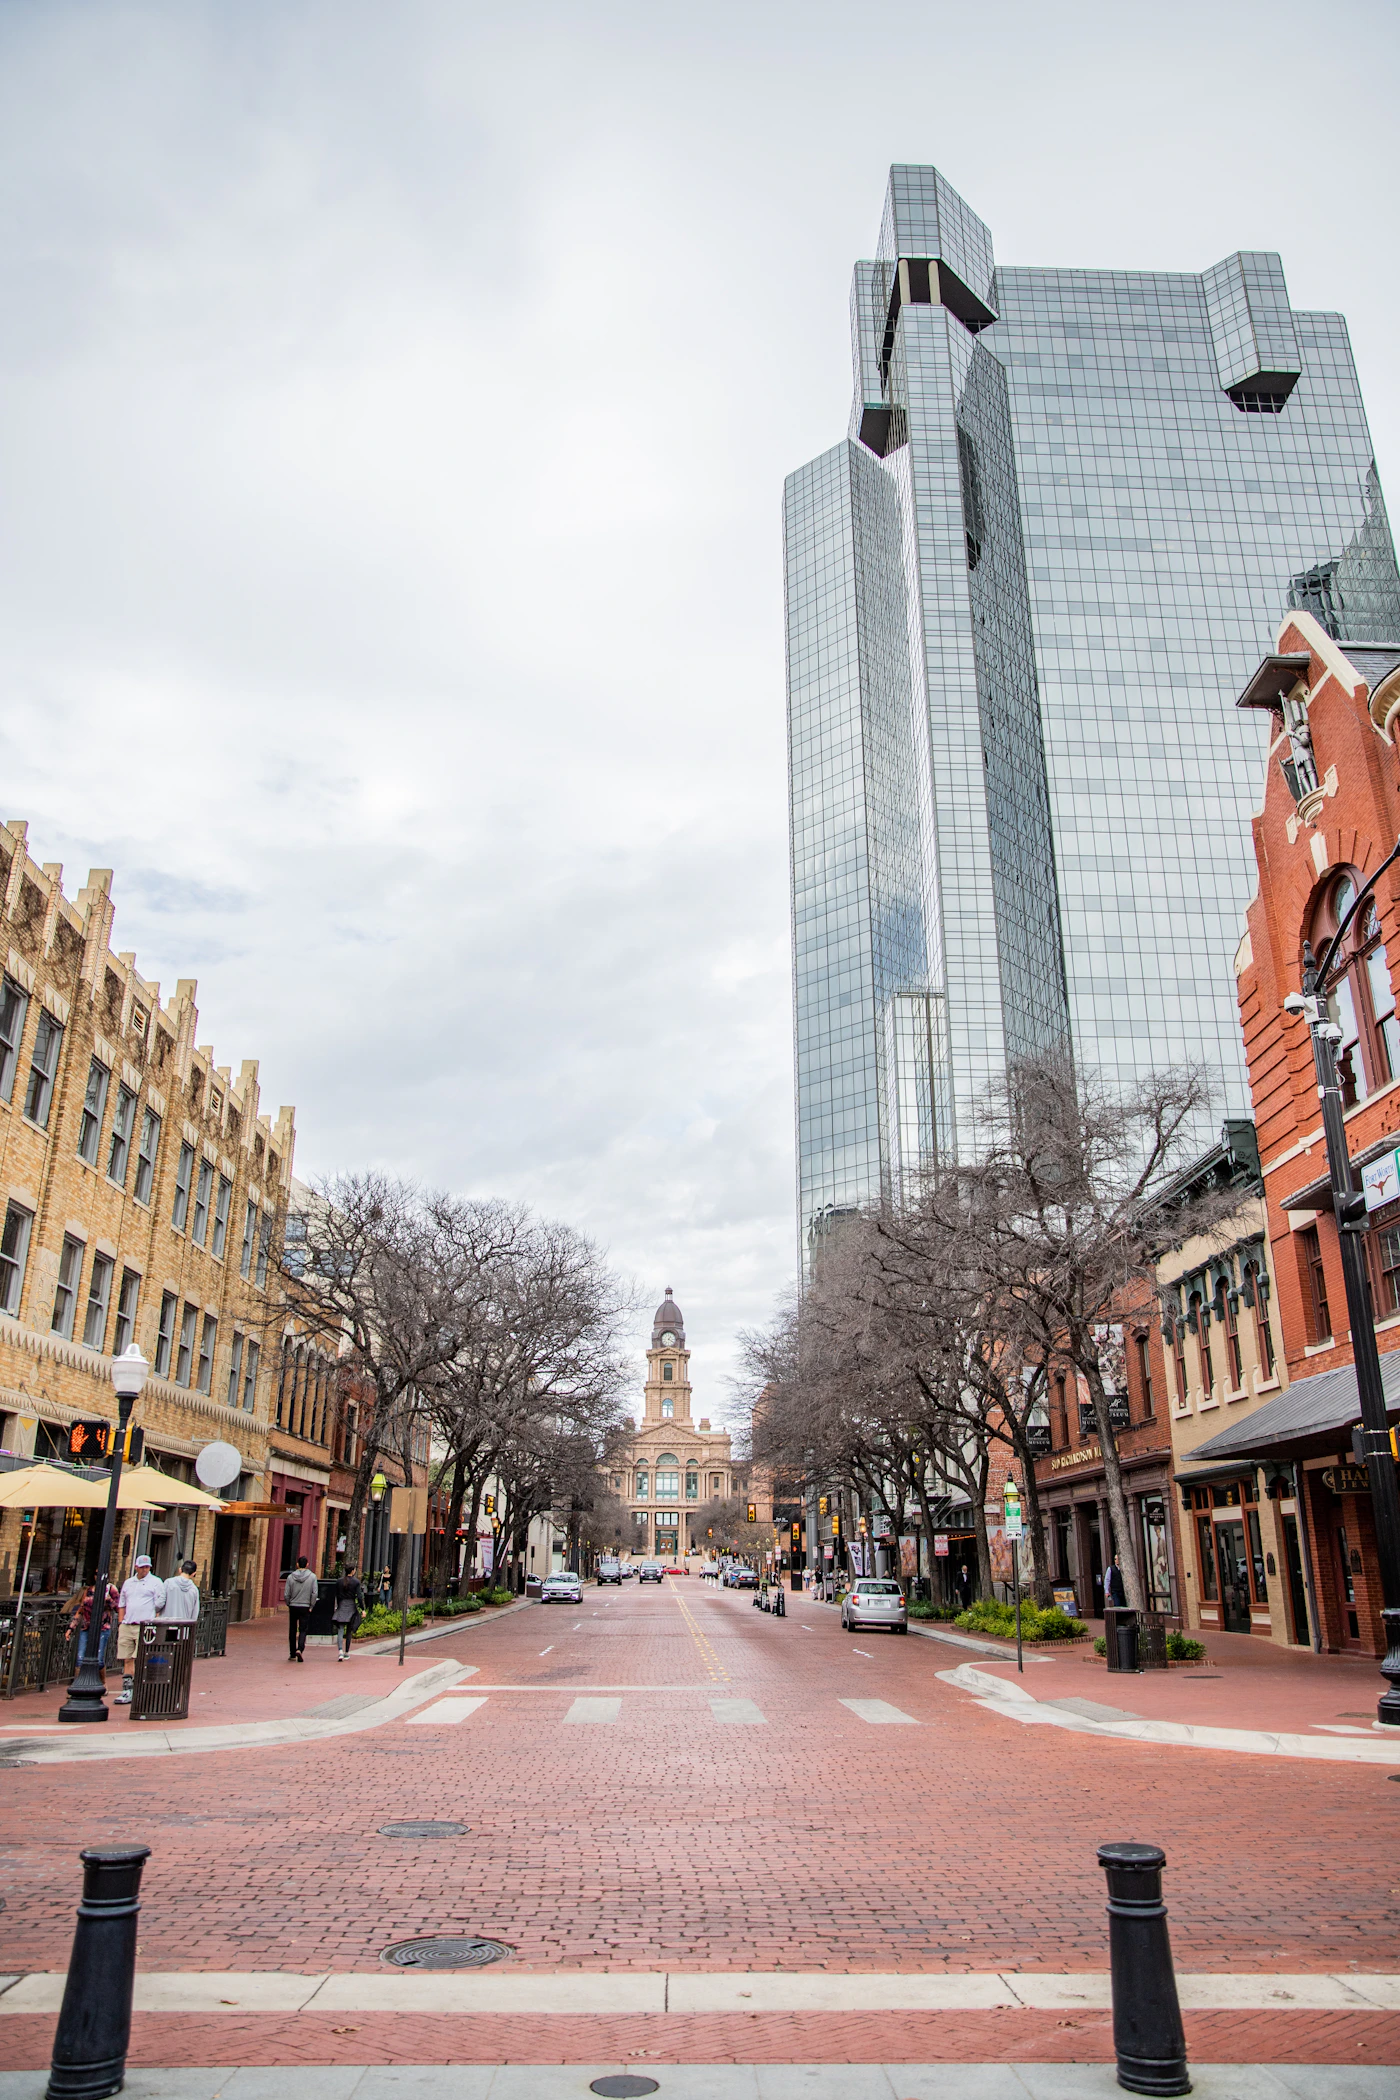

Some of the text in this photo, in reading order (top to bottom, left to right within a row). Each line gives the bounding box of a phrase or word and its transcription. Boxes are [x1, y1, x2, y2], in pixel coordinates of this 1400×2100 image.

[1365, 1164, 1395, 1186] FORT WORTH
[96, 1428, 107, 1451] 4
